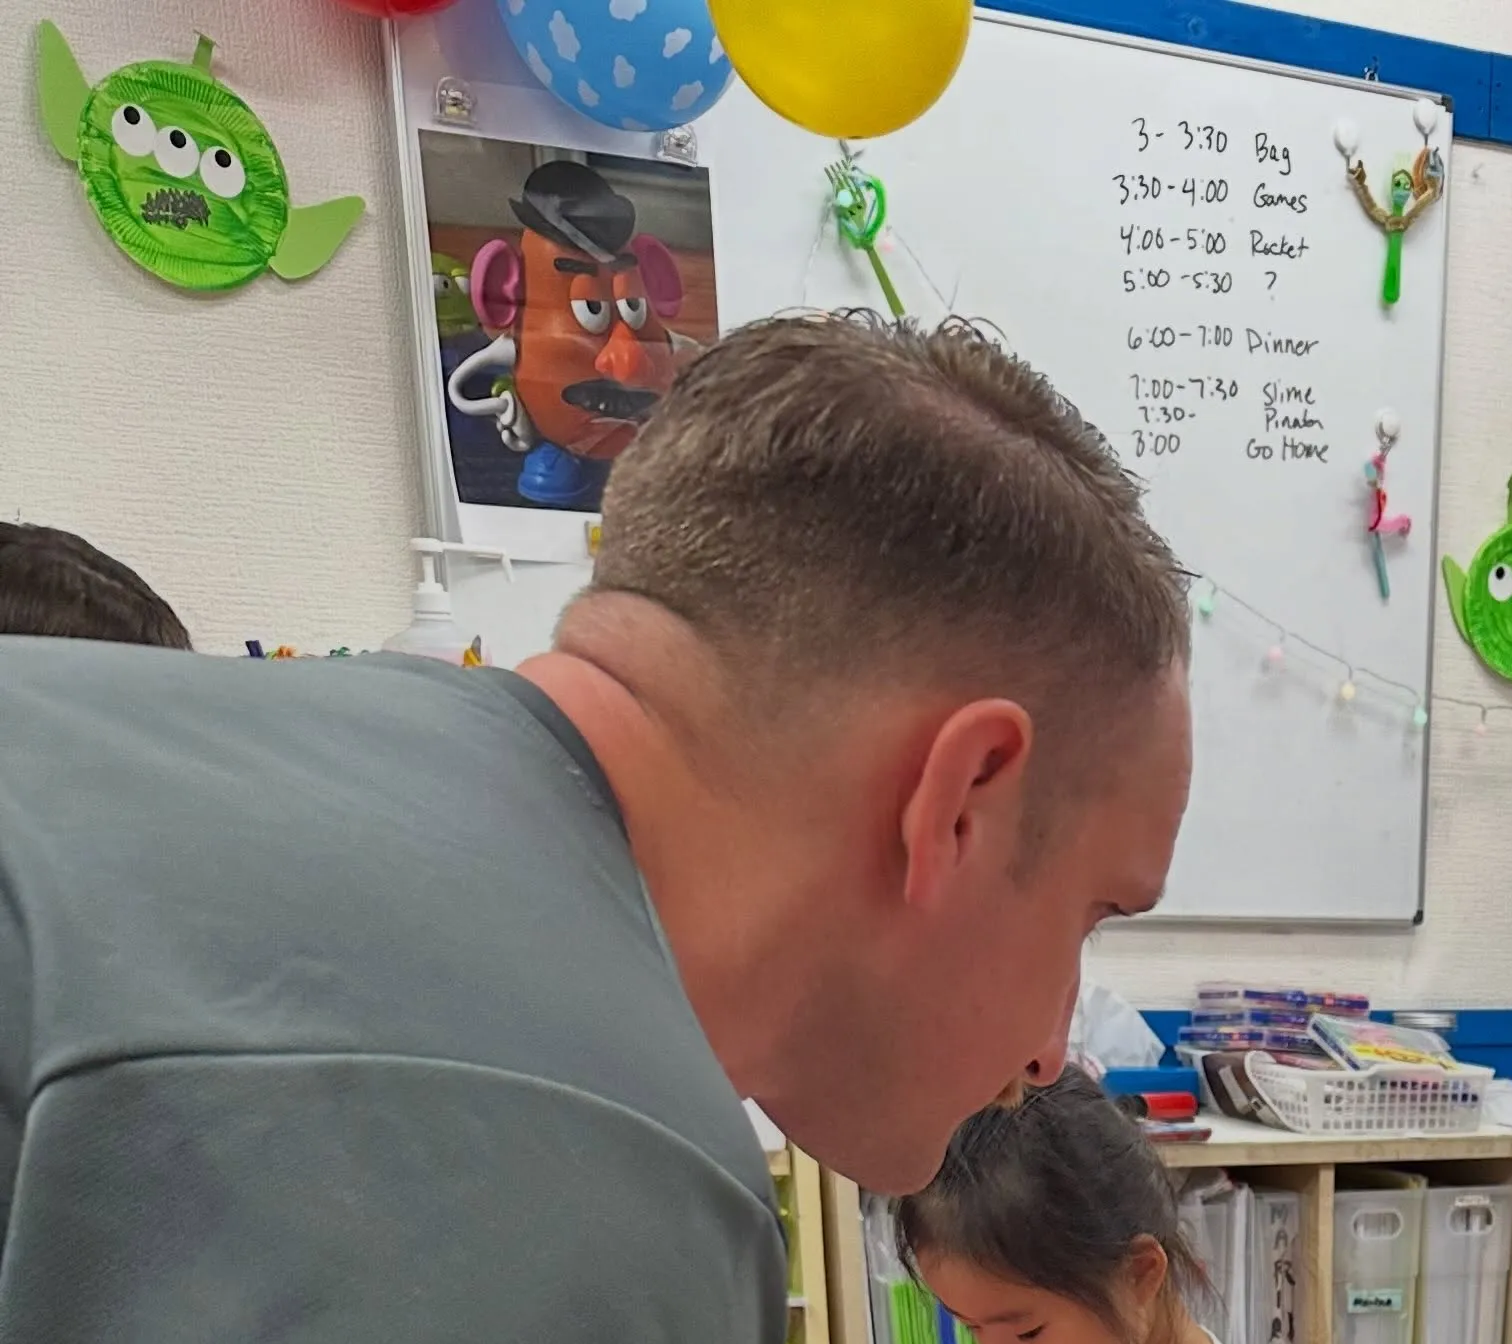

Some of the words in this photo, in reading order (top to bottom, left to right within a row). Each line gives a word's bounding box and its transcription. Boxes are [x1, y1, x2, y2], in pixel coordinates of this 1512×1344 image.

[1255, 132, 1292, 176] Bag
[1253, 182, 1308, 214] Games
[1250, 229, 1310, 259] Rocket
[1246, 327, 1319, 356] Dinner
[1262, 378, 1316, 407] Slime
[1246, 438, 1274, 460] Go
[1282, 435, 1330, 464] Home
